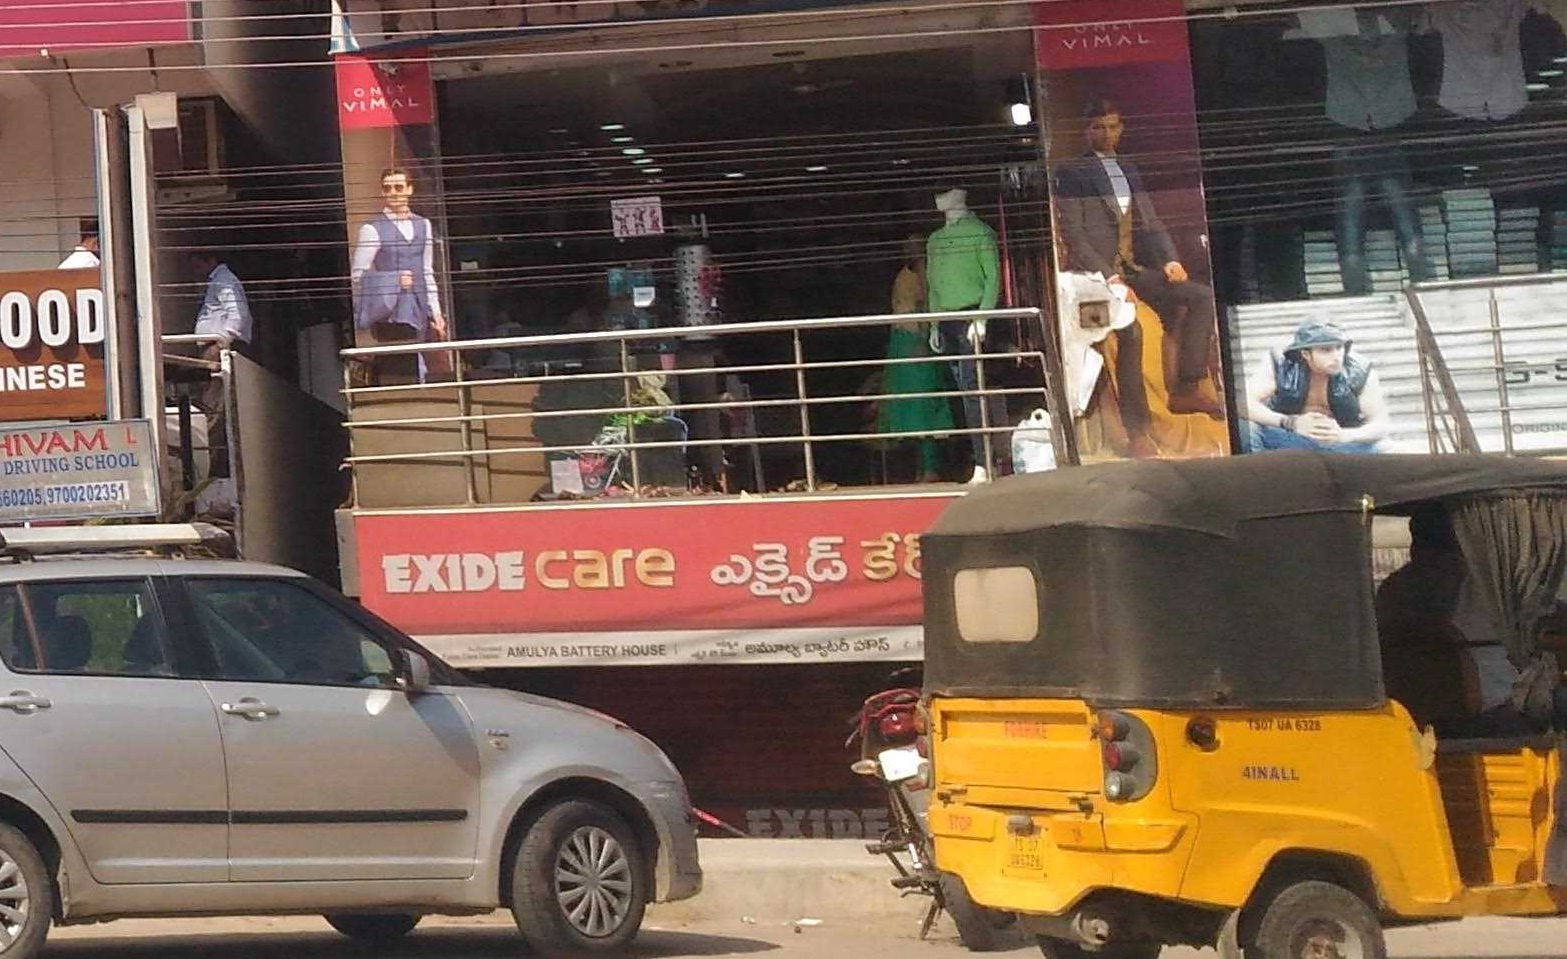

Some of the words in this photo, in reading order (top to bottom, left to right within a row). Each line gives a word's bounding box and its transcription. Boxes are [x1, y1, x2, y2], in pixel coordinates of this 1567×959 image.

[1062, 32, 1152, 50] VIMAL
[353, 83, 404, 98] ONLY
[342, 96, 419, 113] VIMAL
[125, 426, 138, 445] L
[3, 456, 70, 476] DRIVING
[74, 452, 140, 472] SCHOOL
[381, 550, 525, 594] EXIDE
[535, 547, 676, 590] care
[506, 645, 558, 658] AMULYA
[560, 644, 618, 658] BATTERY
[622, 644, 667, 657] HOUSE
[745, 808, 890, 839] EXIDE
